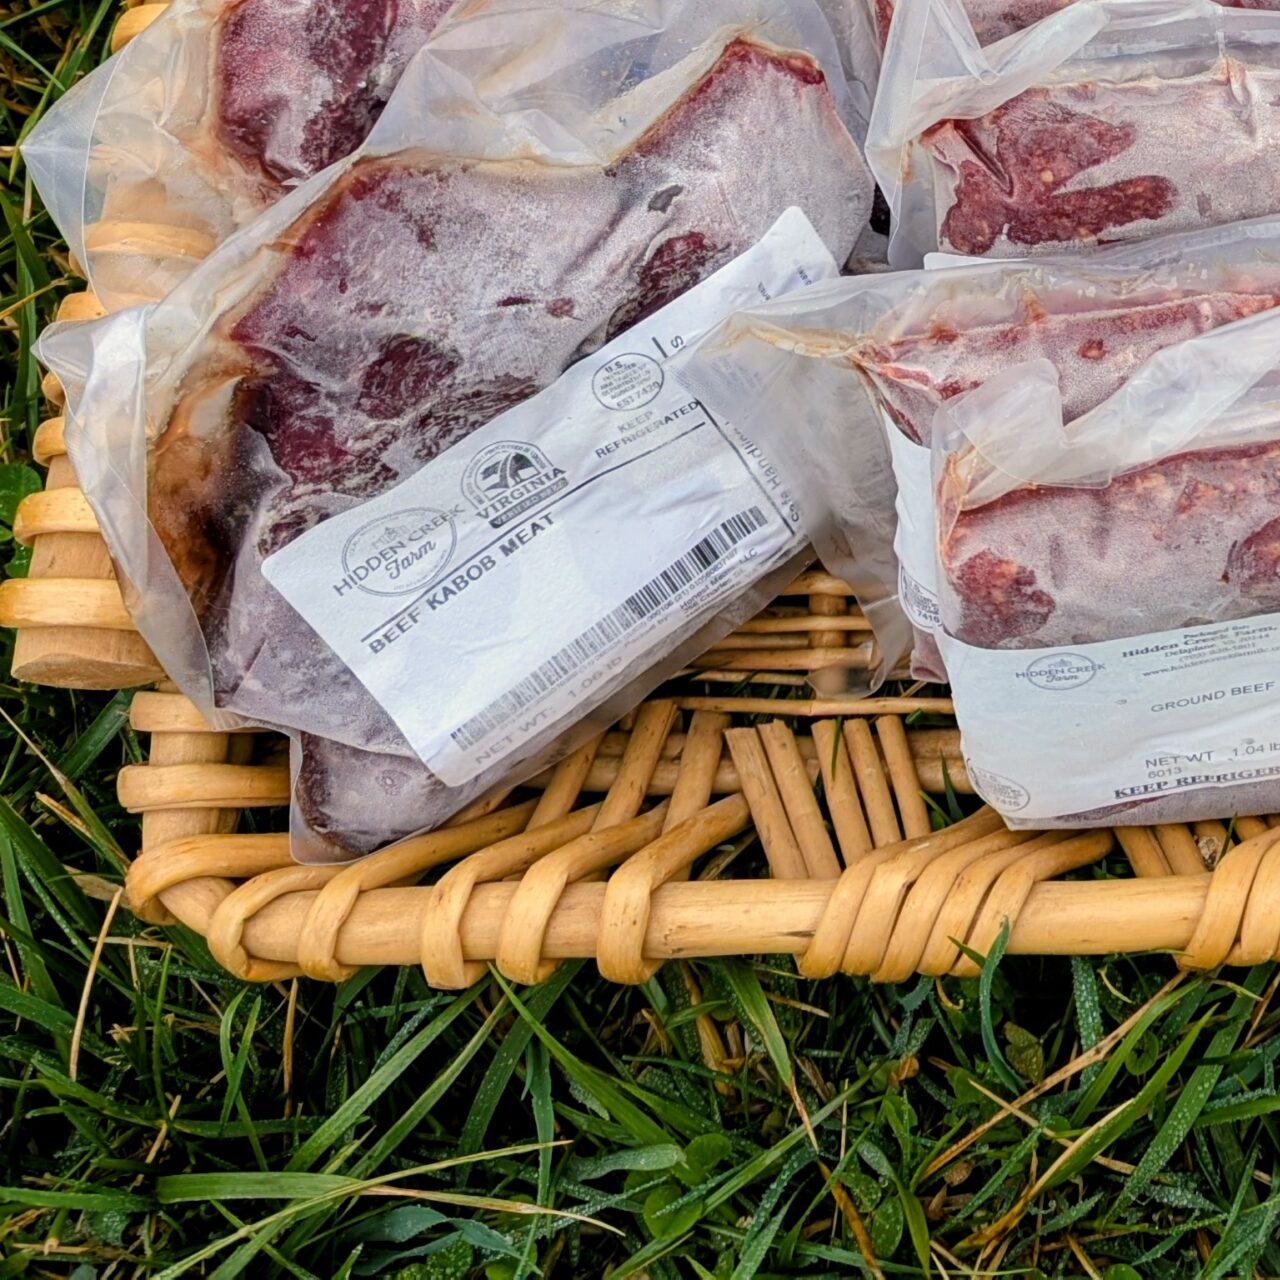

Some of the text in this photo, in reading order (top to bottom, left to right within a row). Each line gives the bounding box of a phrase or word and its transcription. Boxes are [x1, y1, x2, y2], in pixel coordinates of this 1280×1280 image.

[594, 398, 701, 459] REFRIGERATED
[617, 409, 654, 434] KEEP
[474, 464, 566, 522] VIRGINIA
[332, 502, 465, 597] HIDDEN CREEK
[383, 536, 439, 581] Farm
[367, 511, 556, 655] BEEF KABOB MEAT
[1122, 641, 1178, 658] Hidden
[1015, 662, 1106, 680] HIDDEN CREEK
[1045, 671, 1079, 683] Farm
[1150, 681, 1275, 713] GROUND BEEF
[1145, 755, 1181, 768] NET
[1185, 750, 1215, 762] WT
[1231, 744, 1264, 756] 1.04
[1147, 766, 1182, 778] 6013
[1113, 781, 1168, 799] KEEP
